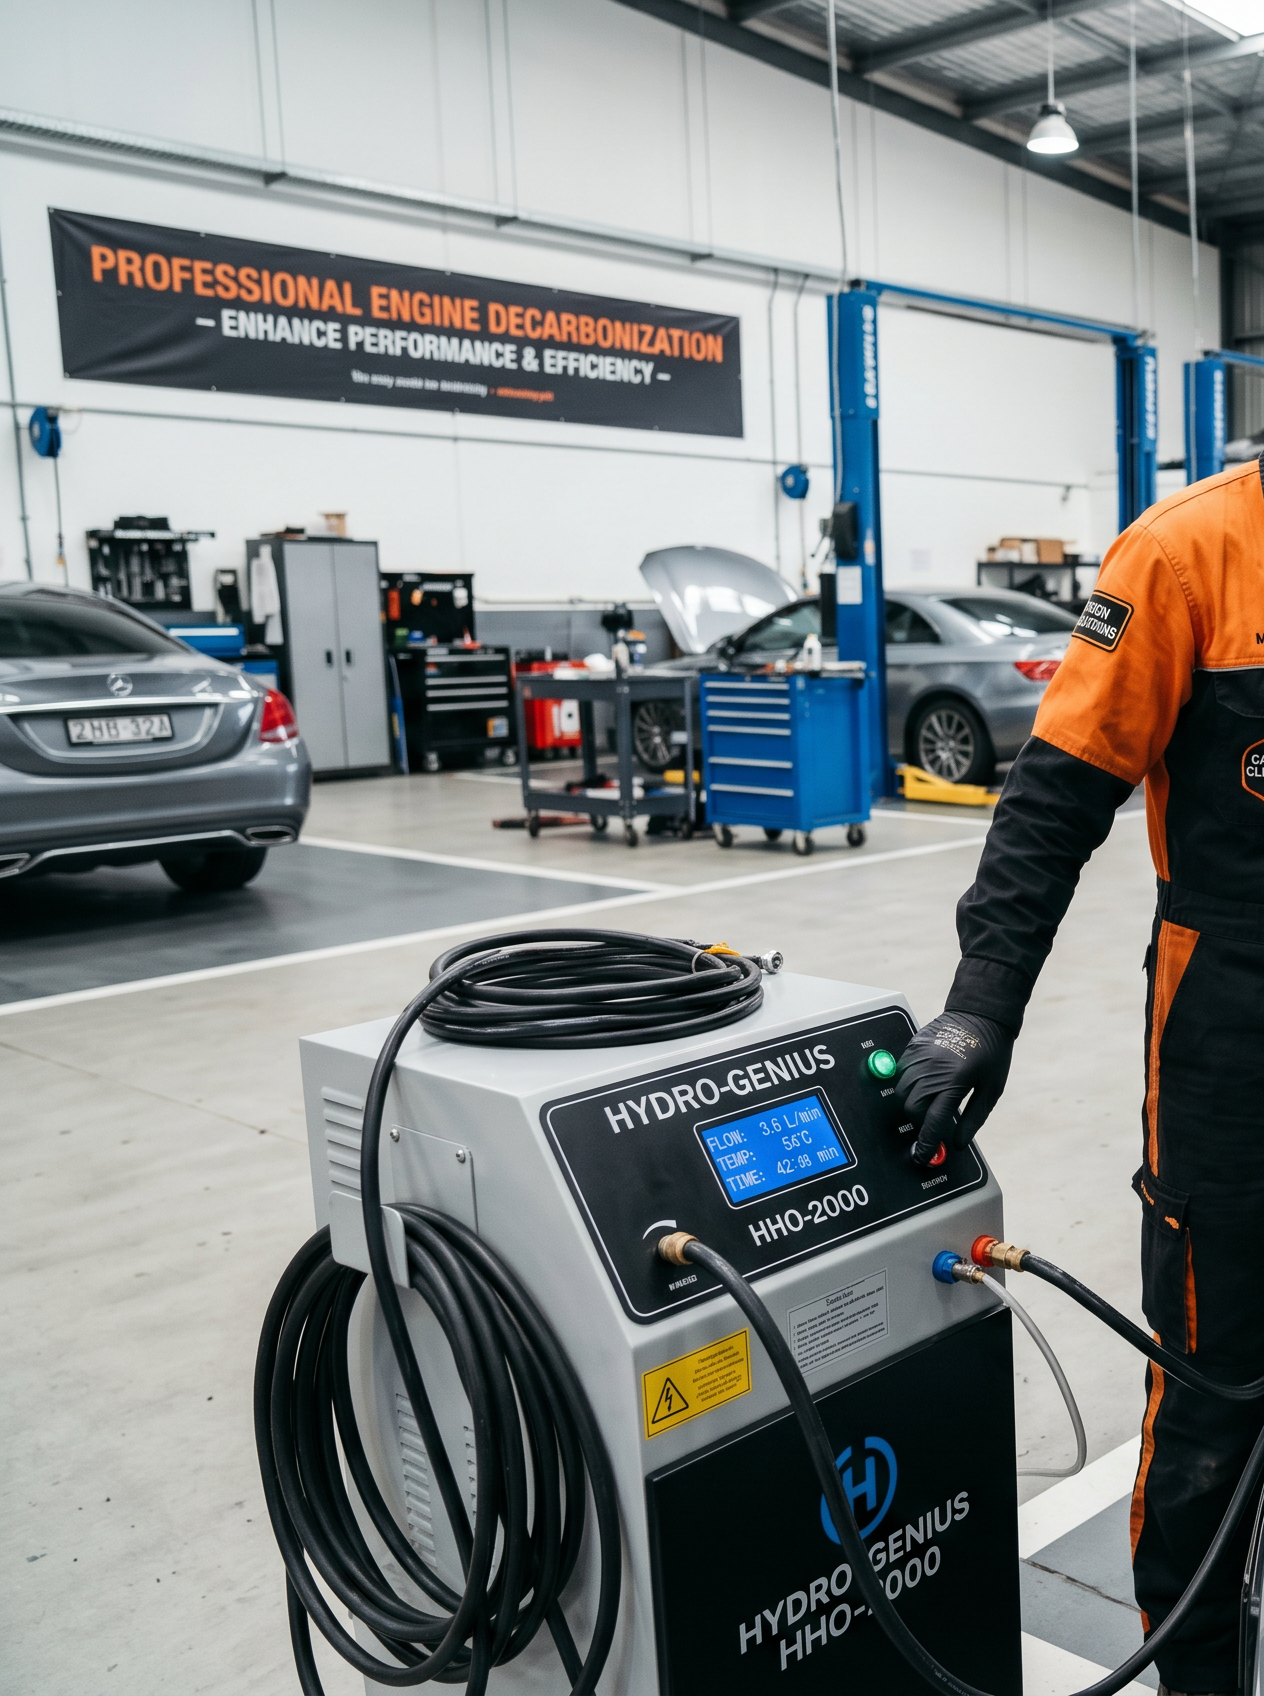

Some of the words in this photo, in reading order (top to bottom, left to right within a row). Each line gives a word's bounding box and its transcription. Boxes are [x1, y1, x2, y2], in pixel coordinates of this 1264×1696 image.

[90, 244, 363, 316] PROFESSIONAL
[370, 285, 481, 333] ENGINE
[489, 302, 724, 363] DECARBONIZATION
[221, 308, 342, 349] ENHANCE
[348, 324, 518, 370] PERFORMANCE
[522, 346, 539, 370] &
[544, 348, 654, 385] EFFICIENCY
[604, 1044, 836, 1134] HYDRO-GENIUS
[706, 1129, 747, 1153] FLOW:
[759, 1117, 782, 1136] 3.6
[716, 1149, 757, 1172] TEMP:
[725, 1169, 766, 1192] TIME:
[816, 1145, 840, 1163] min
[748, 1184, 869, 1247] HHO-2000
